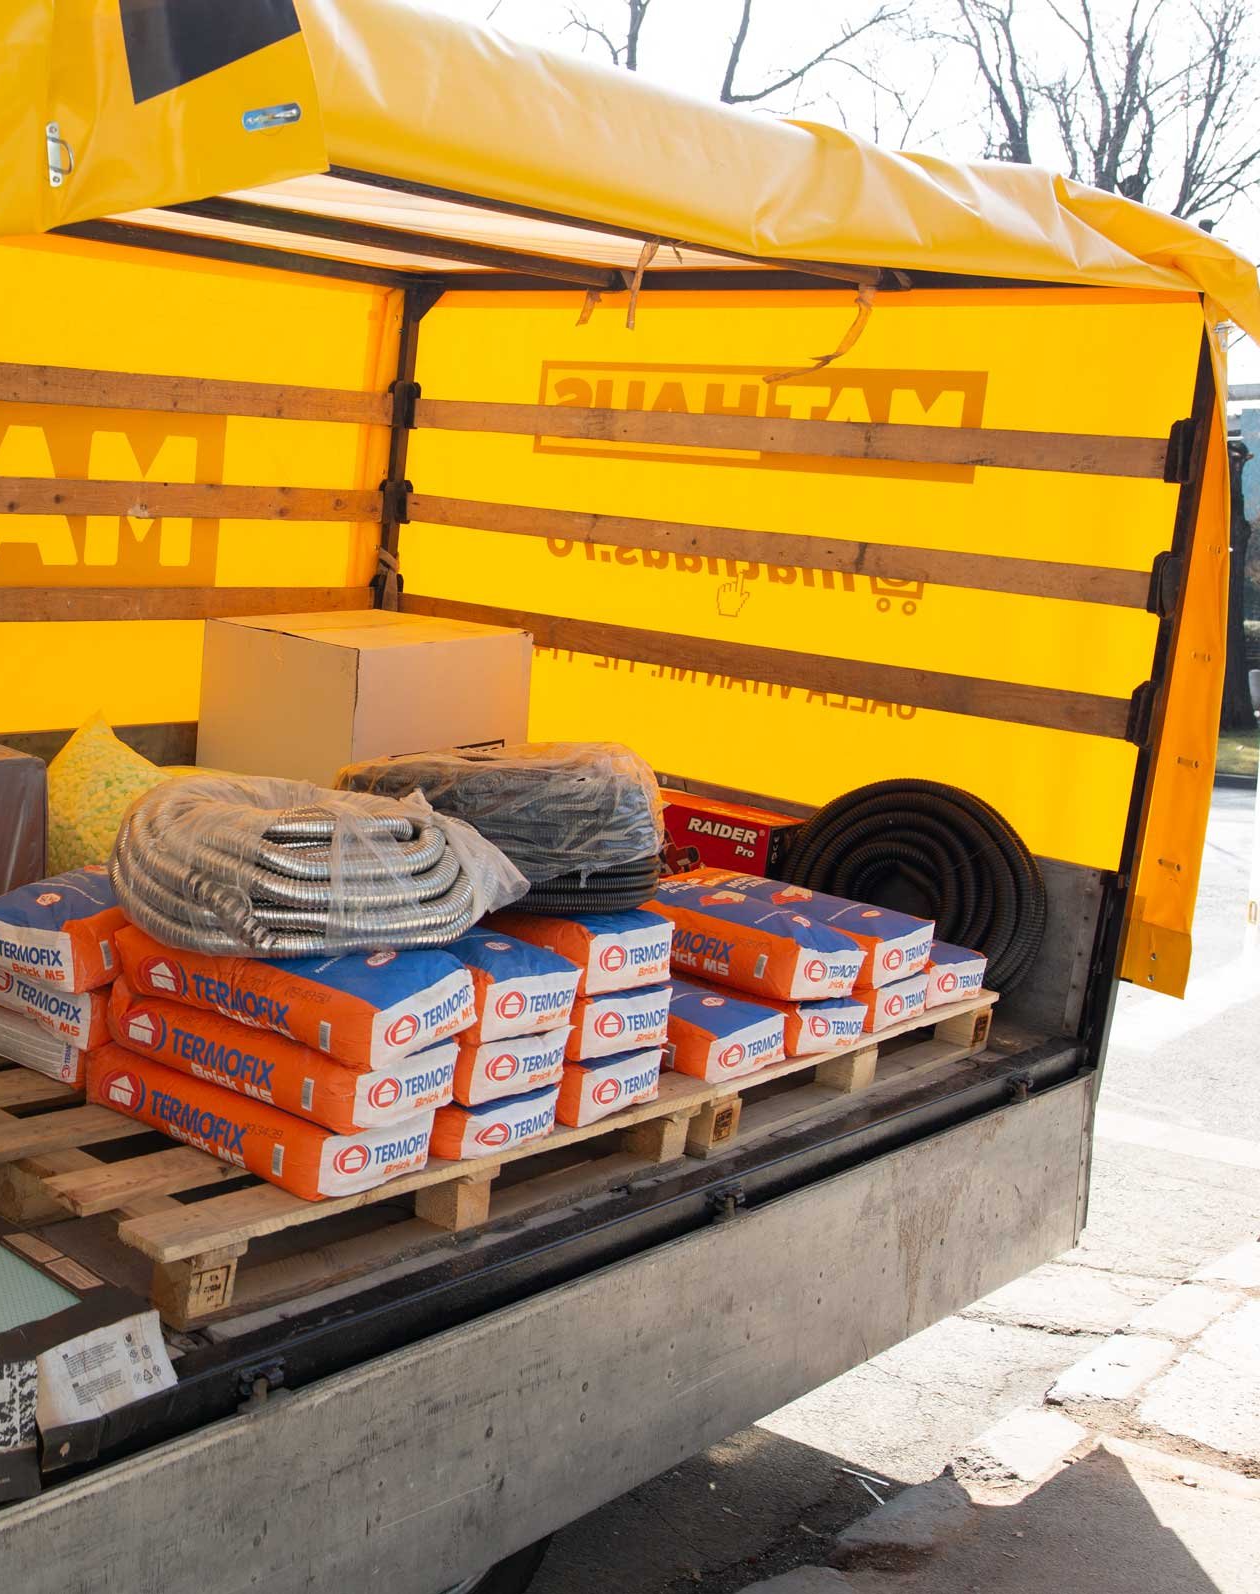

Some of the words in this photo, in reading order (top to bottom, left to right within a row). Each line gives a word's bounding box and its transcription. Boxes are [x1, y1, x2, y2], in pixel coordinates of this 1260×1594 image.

[688, 817, 758, 844] RAIDER
[735, 846, 755, 858] Pro
[672, 929, 735, 964] MOFIX
[672, 949, 698, 967] ick
[12, 964, 42, 978] Brick
[16, 980, 81, 1023] TERMOFIX
[191, 974, 290, 1030] TERMOFIX
[423, 985, 471, 1029] TERMOFIX
[434, 1018, 460, 1036] Brick
[627, 1008, 669, 1032] TERMOFI
[171, 1028, 276, 1090] TERMOFIX
[522, 1050, 564, 1074] TERMOF
[190, 1062, 239, 1091] Brick
[414, 1092, 440, 1108] Brick
[150, 1090, 248, 1154] TERMOFIX
[168, 1124, 214, 1154] Brick
[374, 1130, 429, 1165] TERMOFIX
[383, 1159, 410, 1175] Brick
